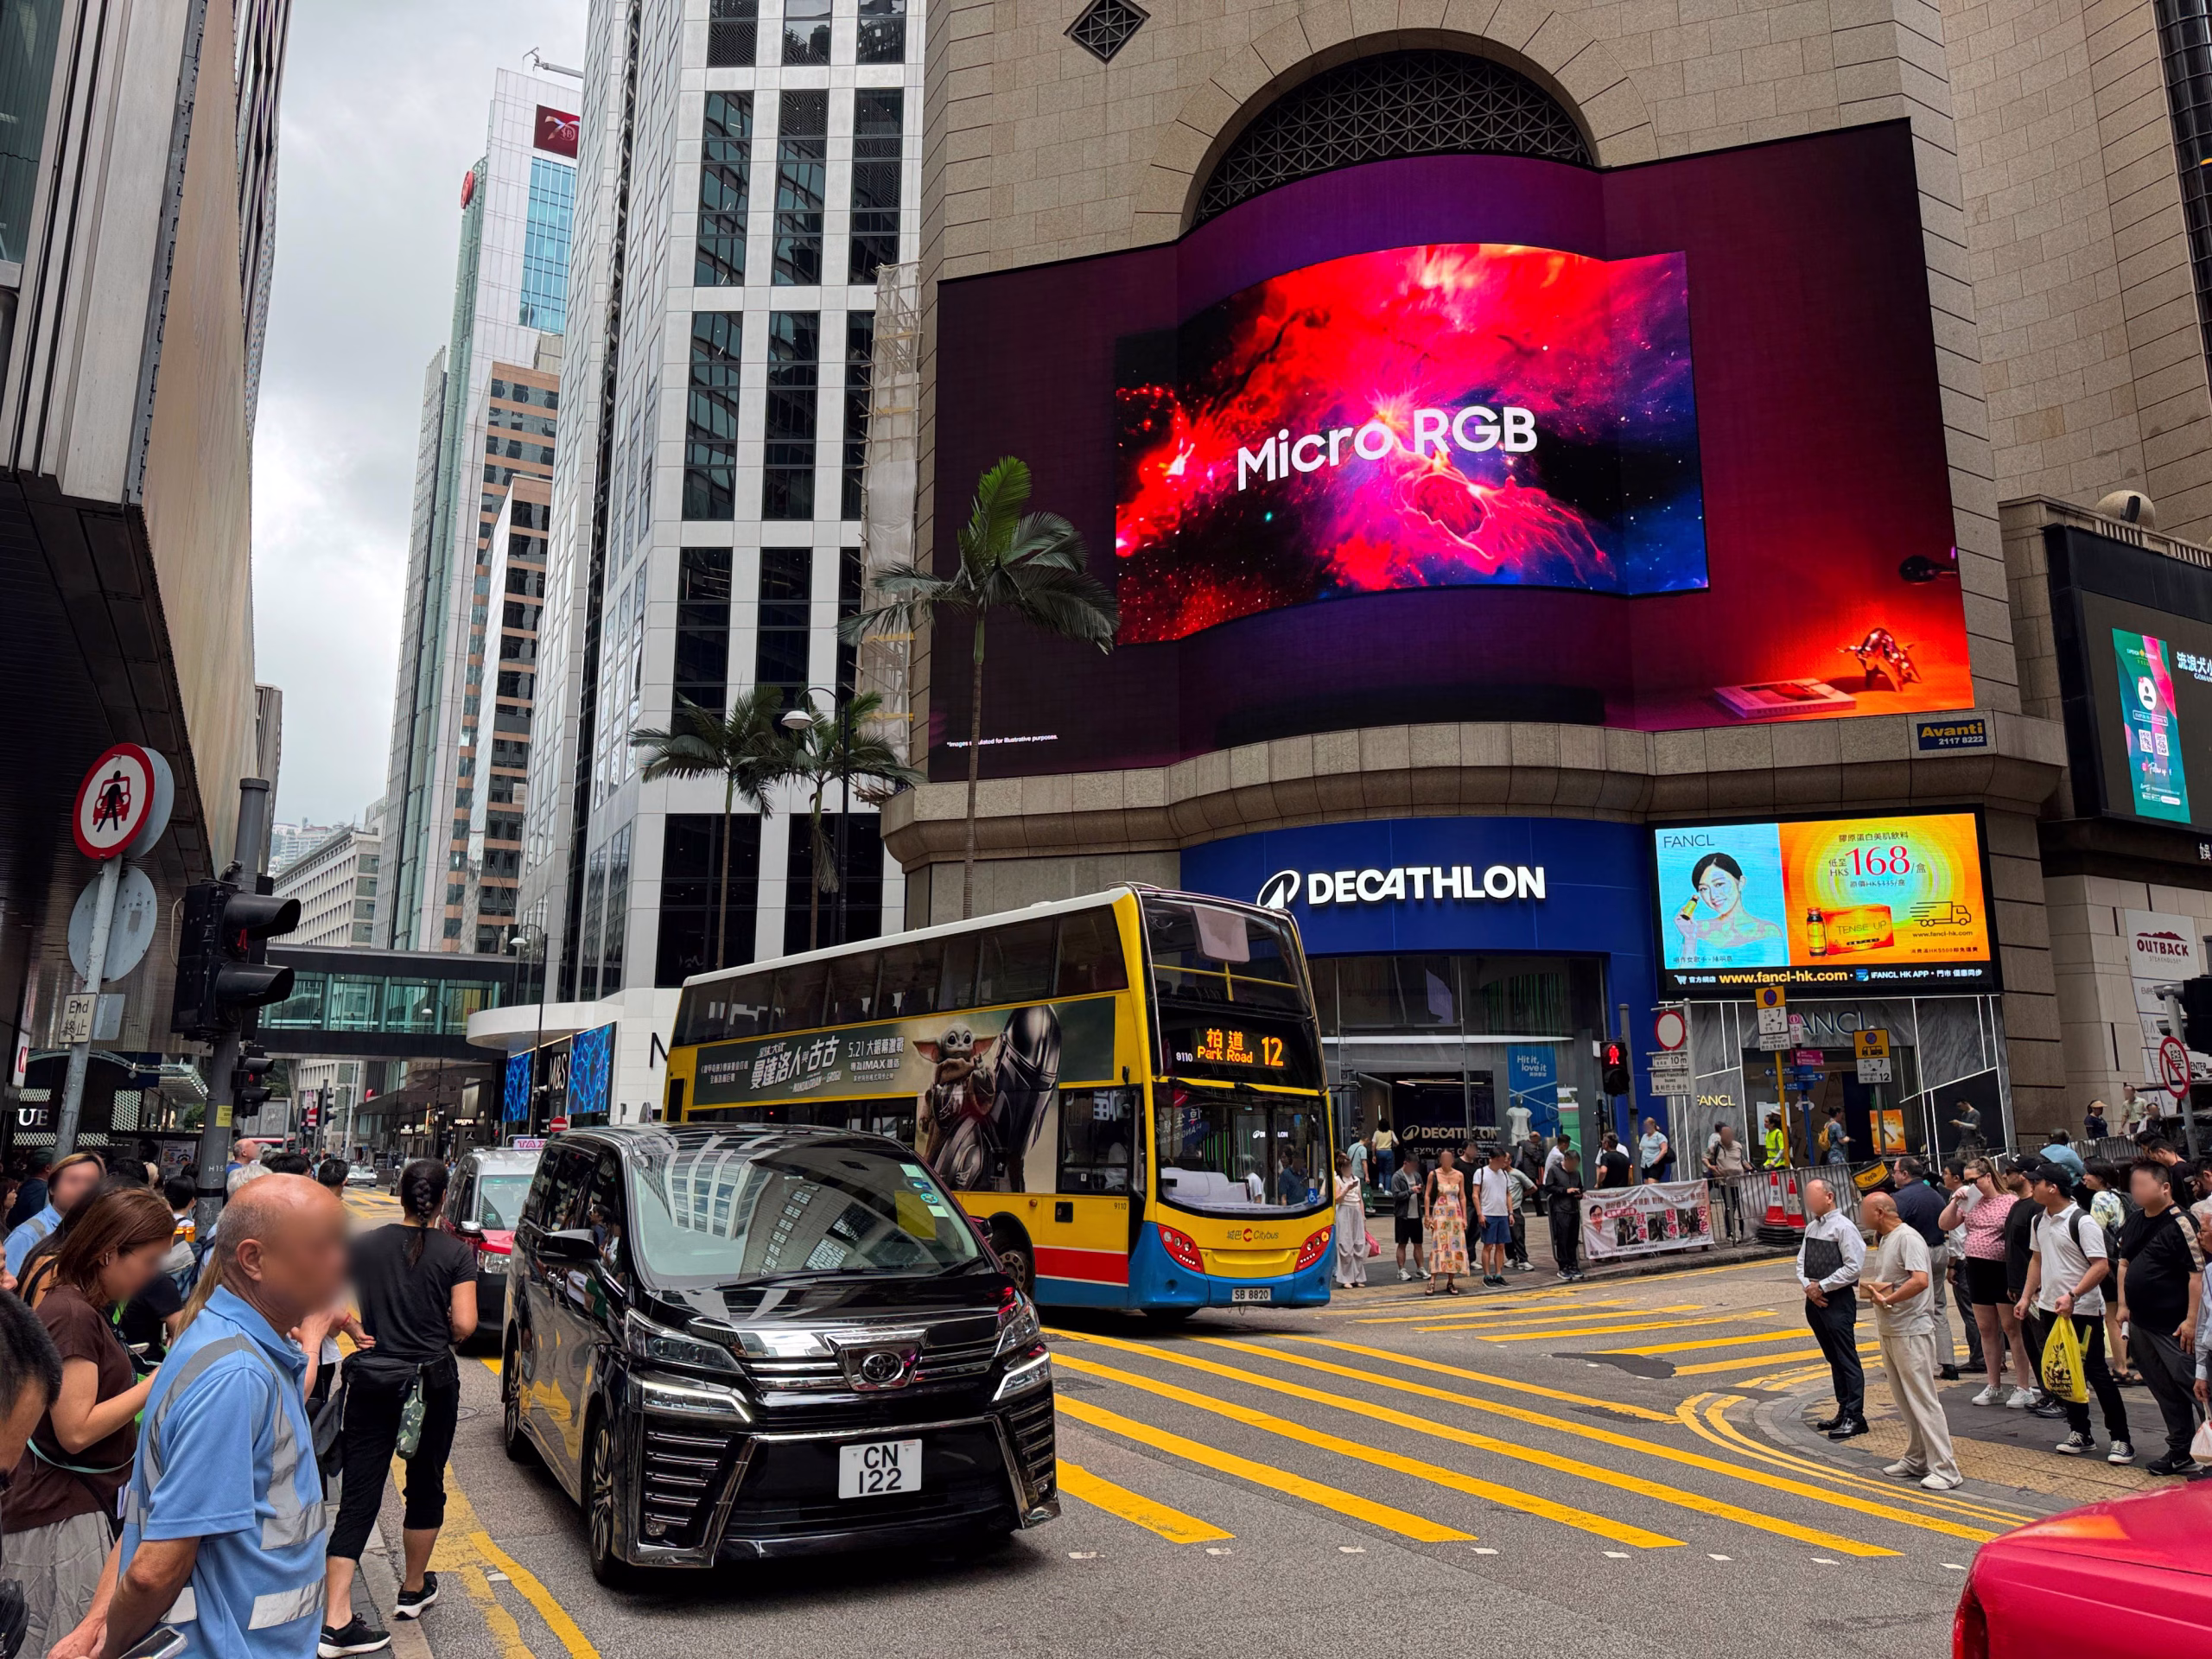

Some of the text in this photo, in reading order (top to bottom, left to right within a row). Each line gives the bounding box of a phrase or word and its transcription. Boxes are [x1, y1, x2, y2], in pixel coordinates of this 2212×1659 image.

[1237, 405, 1538, 492] Micro RGB
[1921, 722, 1983, 738] Avanti
[1663, 834, 1715, 849] FANCL
[1828, 858, 1847, 867] 低至
[1845, 845, 1910, 876] 168
[1307, 865, 1547, 906] DECATHLON
[1836, 920, 1886, 935] TENSE UP
[2136, 939, 2190, 957] OUTBACK
[1719, 969, 1847, 983] www.fancl-hk.com
[68, 999, 90, 1014] End
[1776, 1008, 1781, 1018] 7
[60, 1019, 87, 1040] 終止
[1777, 1021, 1783, 1031] 7
[1206, 1028, 1244, 1051] 柏道
[848, 1040, 865, 1058] 5.21
[1198, 1037, 1284, 1067] Park Road 12
[1175, 1052, 1193, 1062] 9110
[1516, 1055, 1540, 1065] Hit it,
[1877, 1058, 1884, 1068] 7
[547, 1052, 568, 1092] M&S
[1879, 1072, 1891, 1082] 12
[518, 1140, 546, 1148] TAX
[1114, 1202, 1127, 1211] 9110
[1636, 1213, 1648, 1241] 就業
[1666, 1208, 1677, 1238] 醫療
[1697, 1205, 1709, 1234] 安老
[1227, 1230, 1243, 1240] 城巴
[1253, 1230, 1279, 1241] Citybus
[1235, 1289, 1268, 1300] SB 8820
[863, 1444, 898, 1469] CN
[859, 1467, 901, 1494] 122
